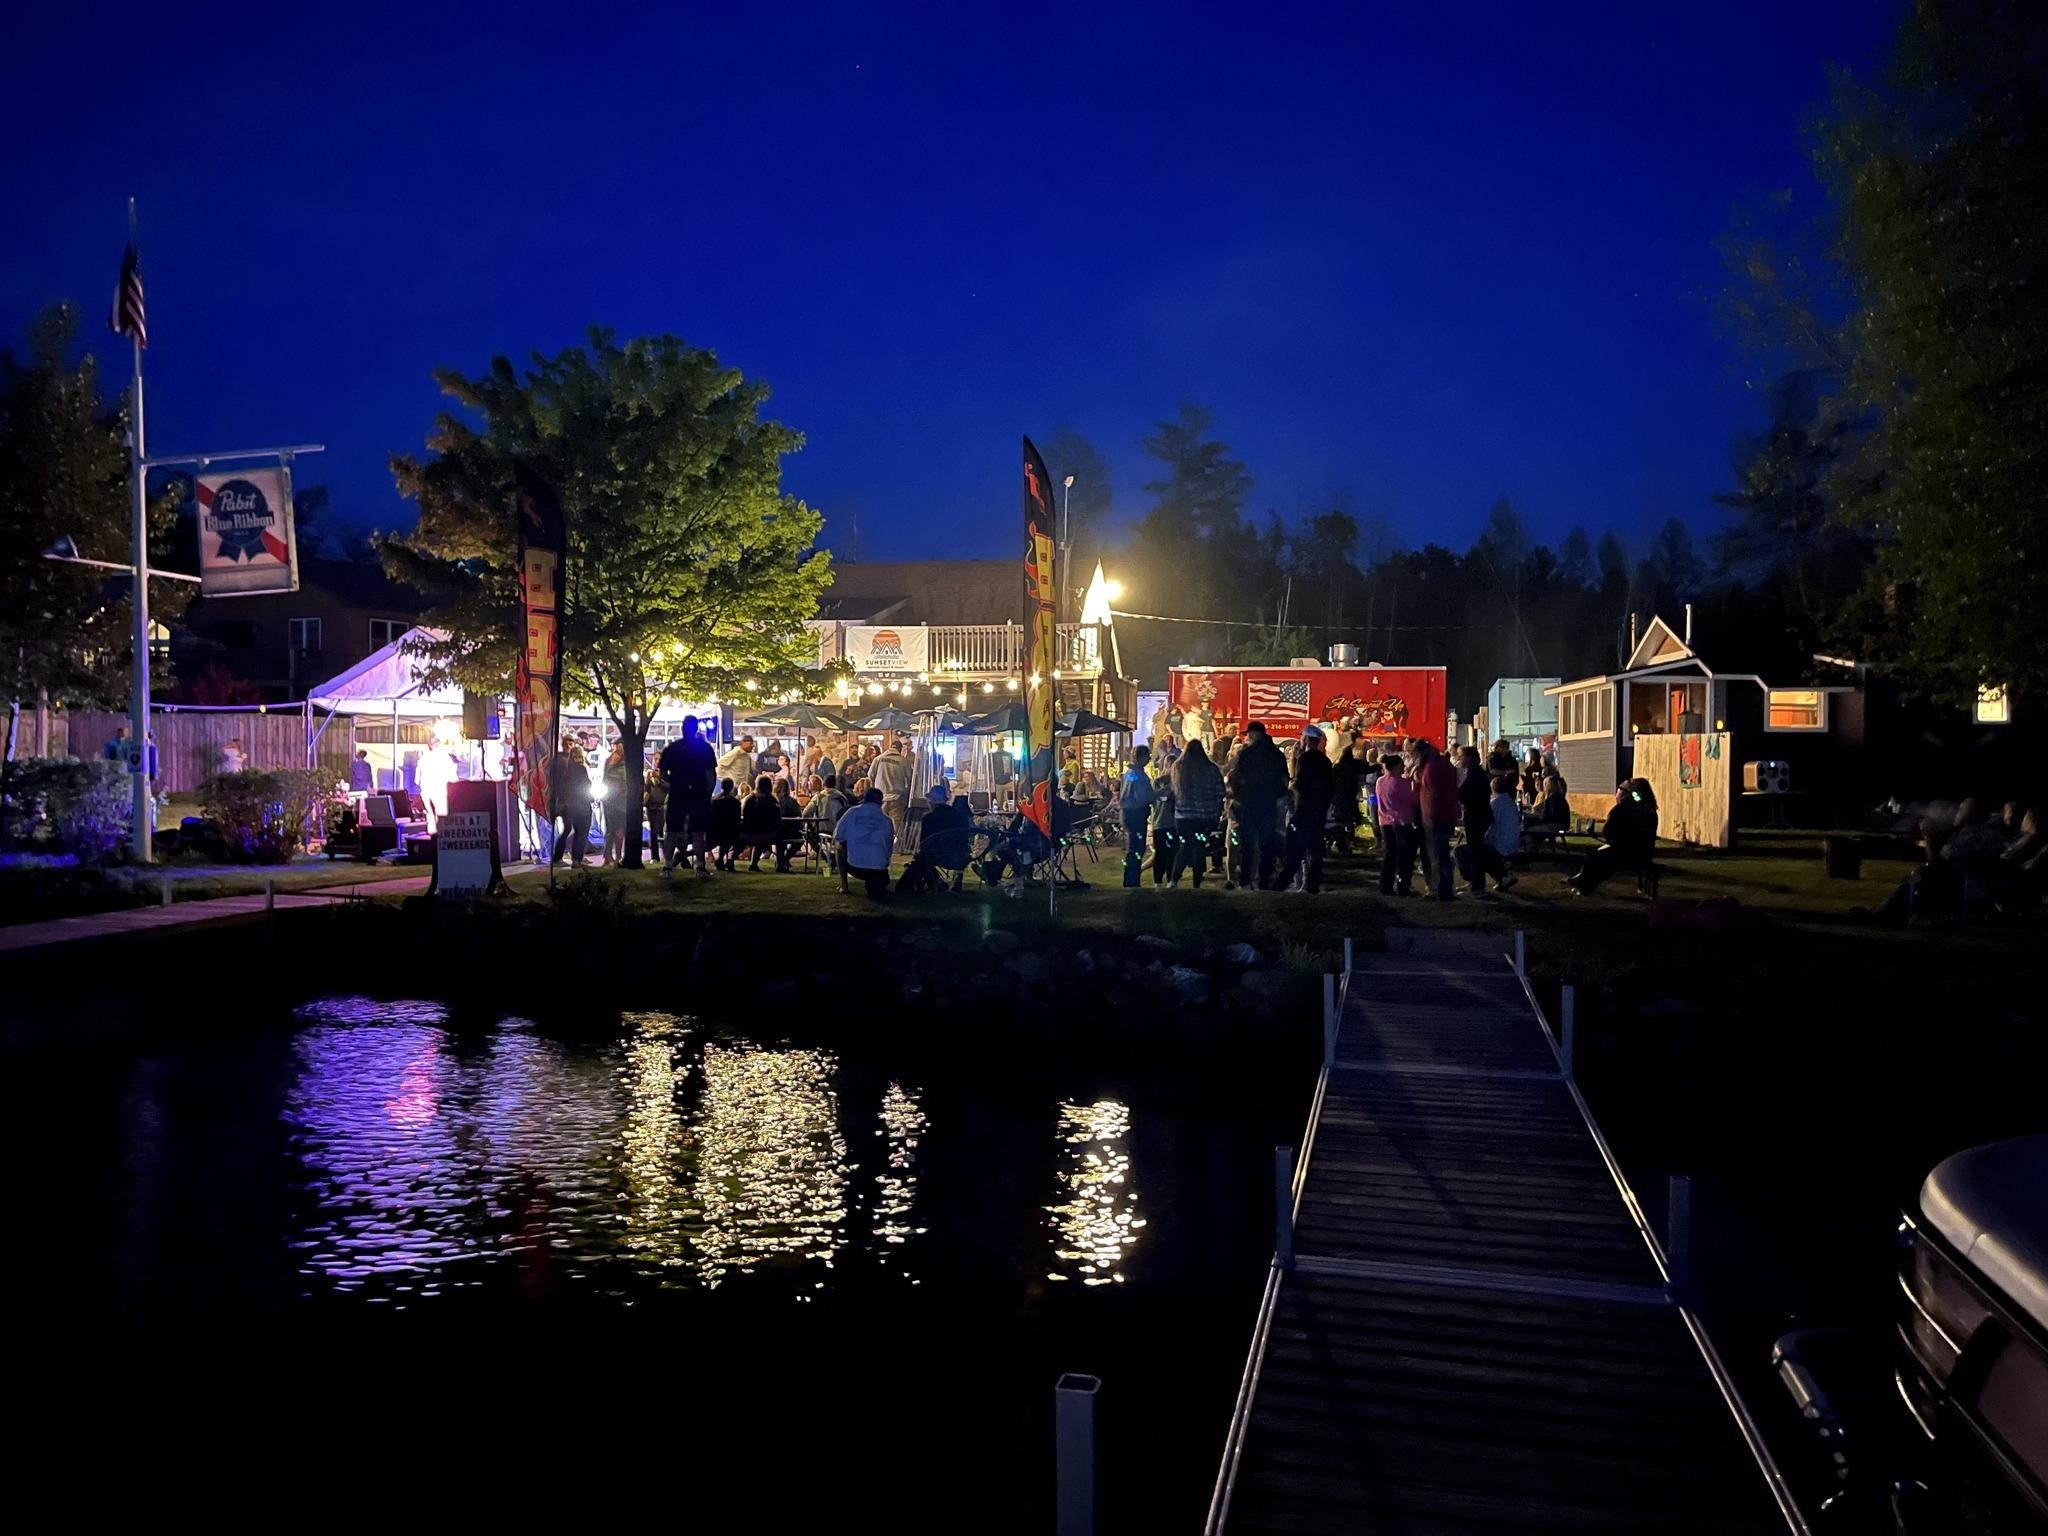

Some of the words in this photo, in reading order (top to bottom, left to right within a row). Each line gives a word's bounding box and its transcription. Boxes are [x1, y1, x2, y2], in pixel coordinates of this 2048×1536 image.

[219, 490, 257, 511] Pabst
[206, 515, 233, 530] Blue
[233, 512, 273, 529] Ribbon
[469, 815, 481, 826] AT
